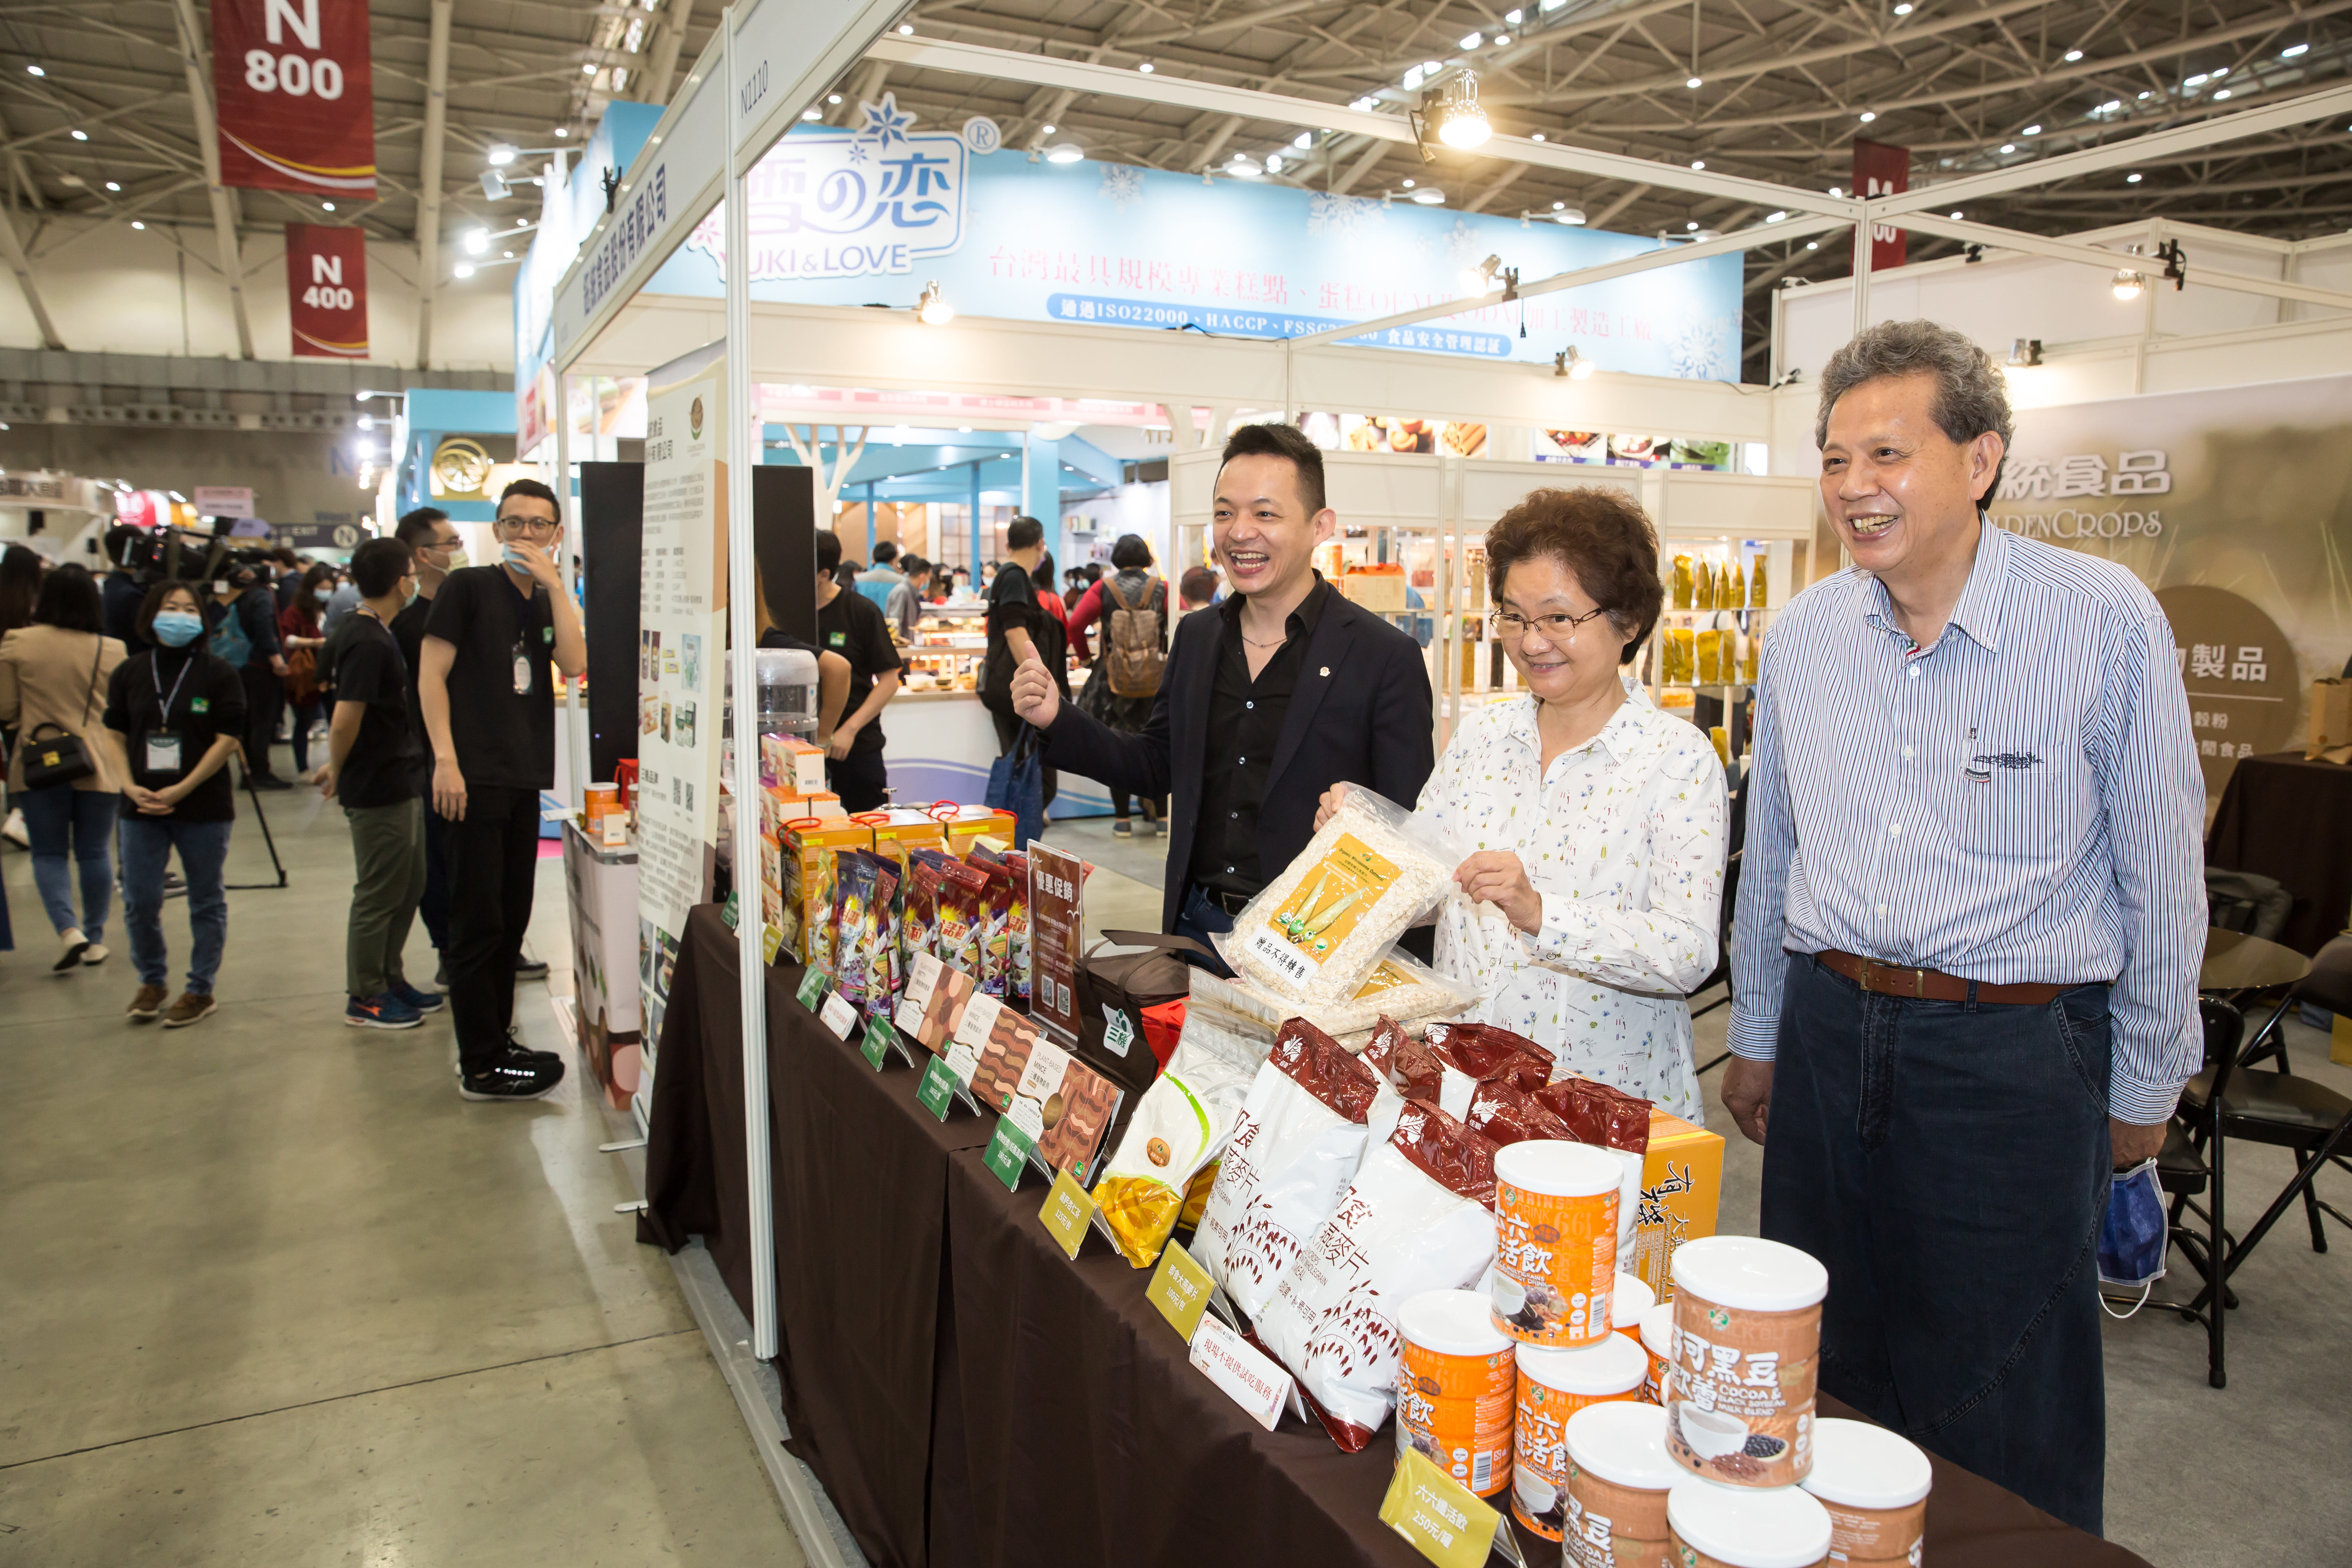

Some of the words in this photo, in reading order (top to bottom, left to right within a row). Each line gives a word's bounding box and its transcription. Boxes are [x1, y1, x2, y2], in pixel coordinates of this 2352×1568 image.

[265, 0, 321, 50] N
[245, 49, 344, 100] 800
[741, 60, 768, 118] N1110
[311, 254, 342, 285] N
[719, 245, 907, 275] UKI&LOVE
[302, 287, 354, 310] 400
[1996, 449, 2172, 501] 統食品
[1339, 848, 1352, 858] Organic
[1351, 855, 1370, 871] Wholesome
[1370, 869, 1385, 882] Oatmeal
[1036, 869, 1073, 903] 優惠促銷
[1254, 936, 1305, 979] 贈品不得轉售
[968, 1010, 980, 1022] MINCE
[971, 1002, 993, 1020] PLANT-BASED
[1106, 1026, 1129, 1050] 三機
[1033, 1060, 1047, 1075] MINCE
[1036, 1051, 1062, 1074] PLANT-BASED
[1055, 1209, 1072, 1231] 125元/包
[1058, 1191, 1082, 1220] 高鈣杏仁茶
[1313, 1221, 1369, 1281] 燕麥片
[1494, 1238, 1553, 1276] 活飲
[1167, 1263, 1199, 1301] 即食大燕麥片
[1528, 1278, 1548, 1287] DRINK
[1659, 1277, 1667, 1304] Oatmeal
[1166, 1286, 1186, 1312] 100元/包
[1204, 1337, 1273, 1401] 現場不提供試吃服務
[1717, 1394, 1747, 1406] BLACK
[1719, 1384, 1769, 1401] COCOA
[1771, 1387, 1783, 1400] &
[1517, 1397, 1561, 1441] 六六
[1717, 1403, 1742, 1414] MILK
[1744, 1407, 1776, 1417] BLEND
[1415, 1484, 1468, 1533] 六六纖活飲
[1412, 1509, 1454, 1549] 250元/罐
[1568, 1531, 1602, 1561] COCOA
